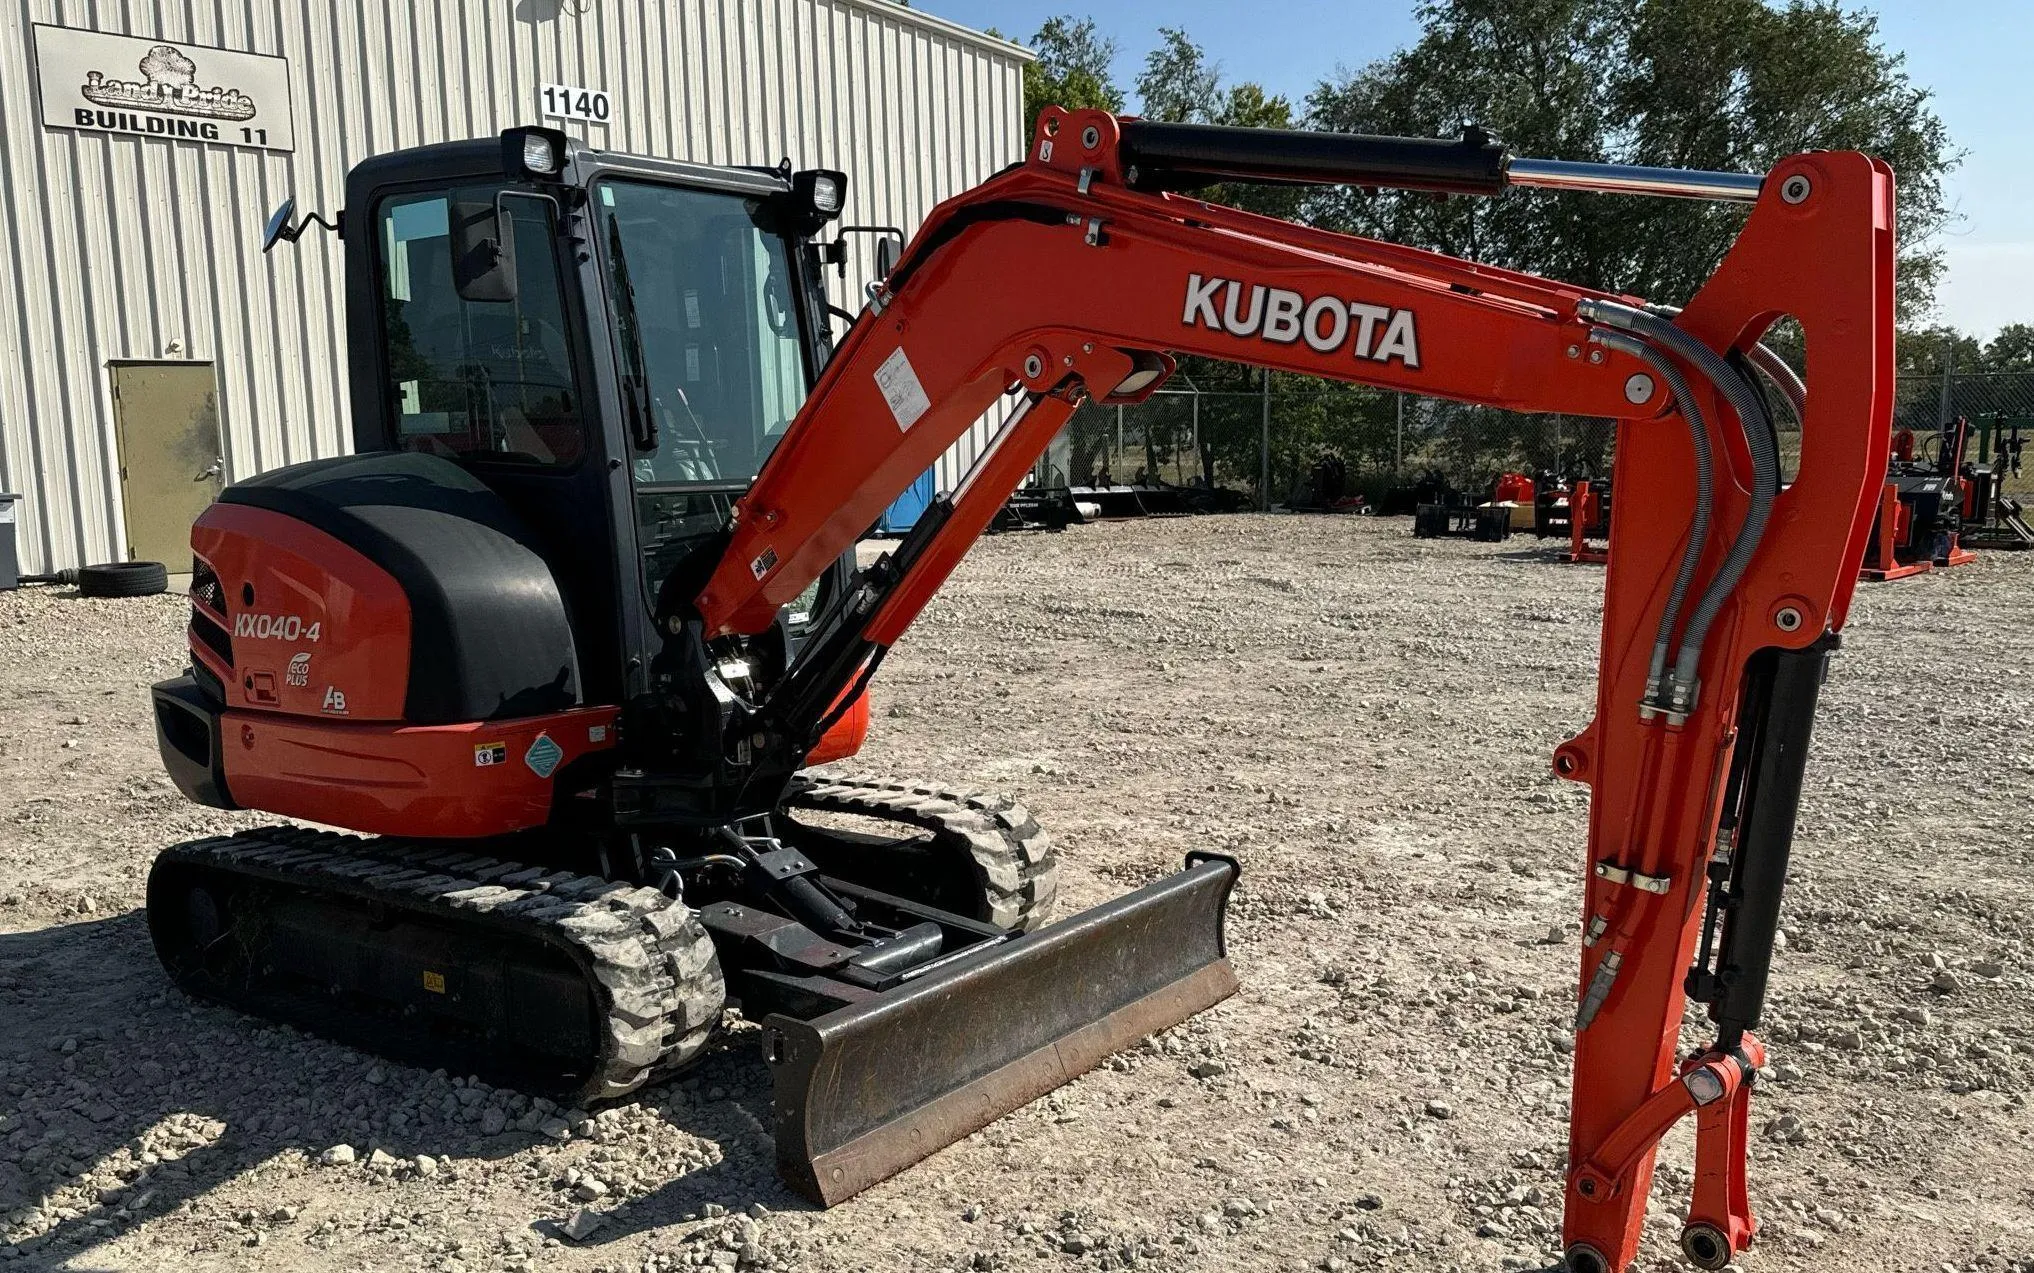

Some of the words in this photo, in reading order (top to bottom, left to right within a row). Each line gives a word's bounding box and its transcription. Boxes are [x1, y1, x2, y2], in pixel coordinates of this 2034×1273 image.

[86, 71, 159, 103] Land
[178, 83, 253, 111] Pride
[543, 87, 609, 120] 1140
[74, 108, 219, 140] BUILDING
[240, 127, 267, 145] 11
[1182, 273, 1419, 368] KUBOTA
[234, 613, 321, 642] KX040-4
[286, 674, 308, 687] PLUS
[291, 663, 309, 674] eco
